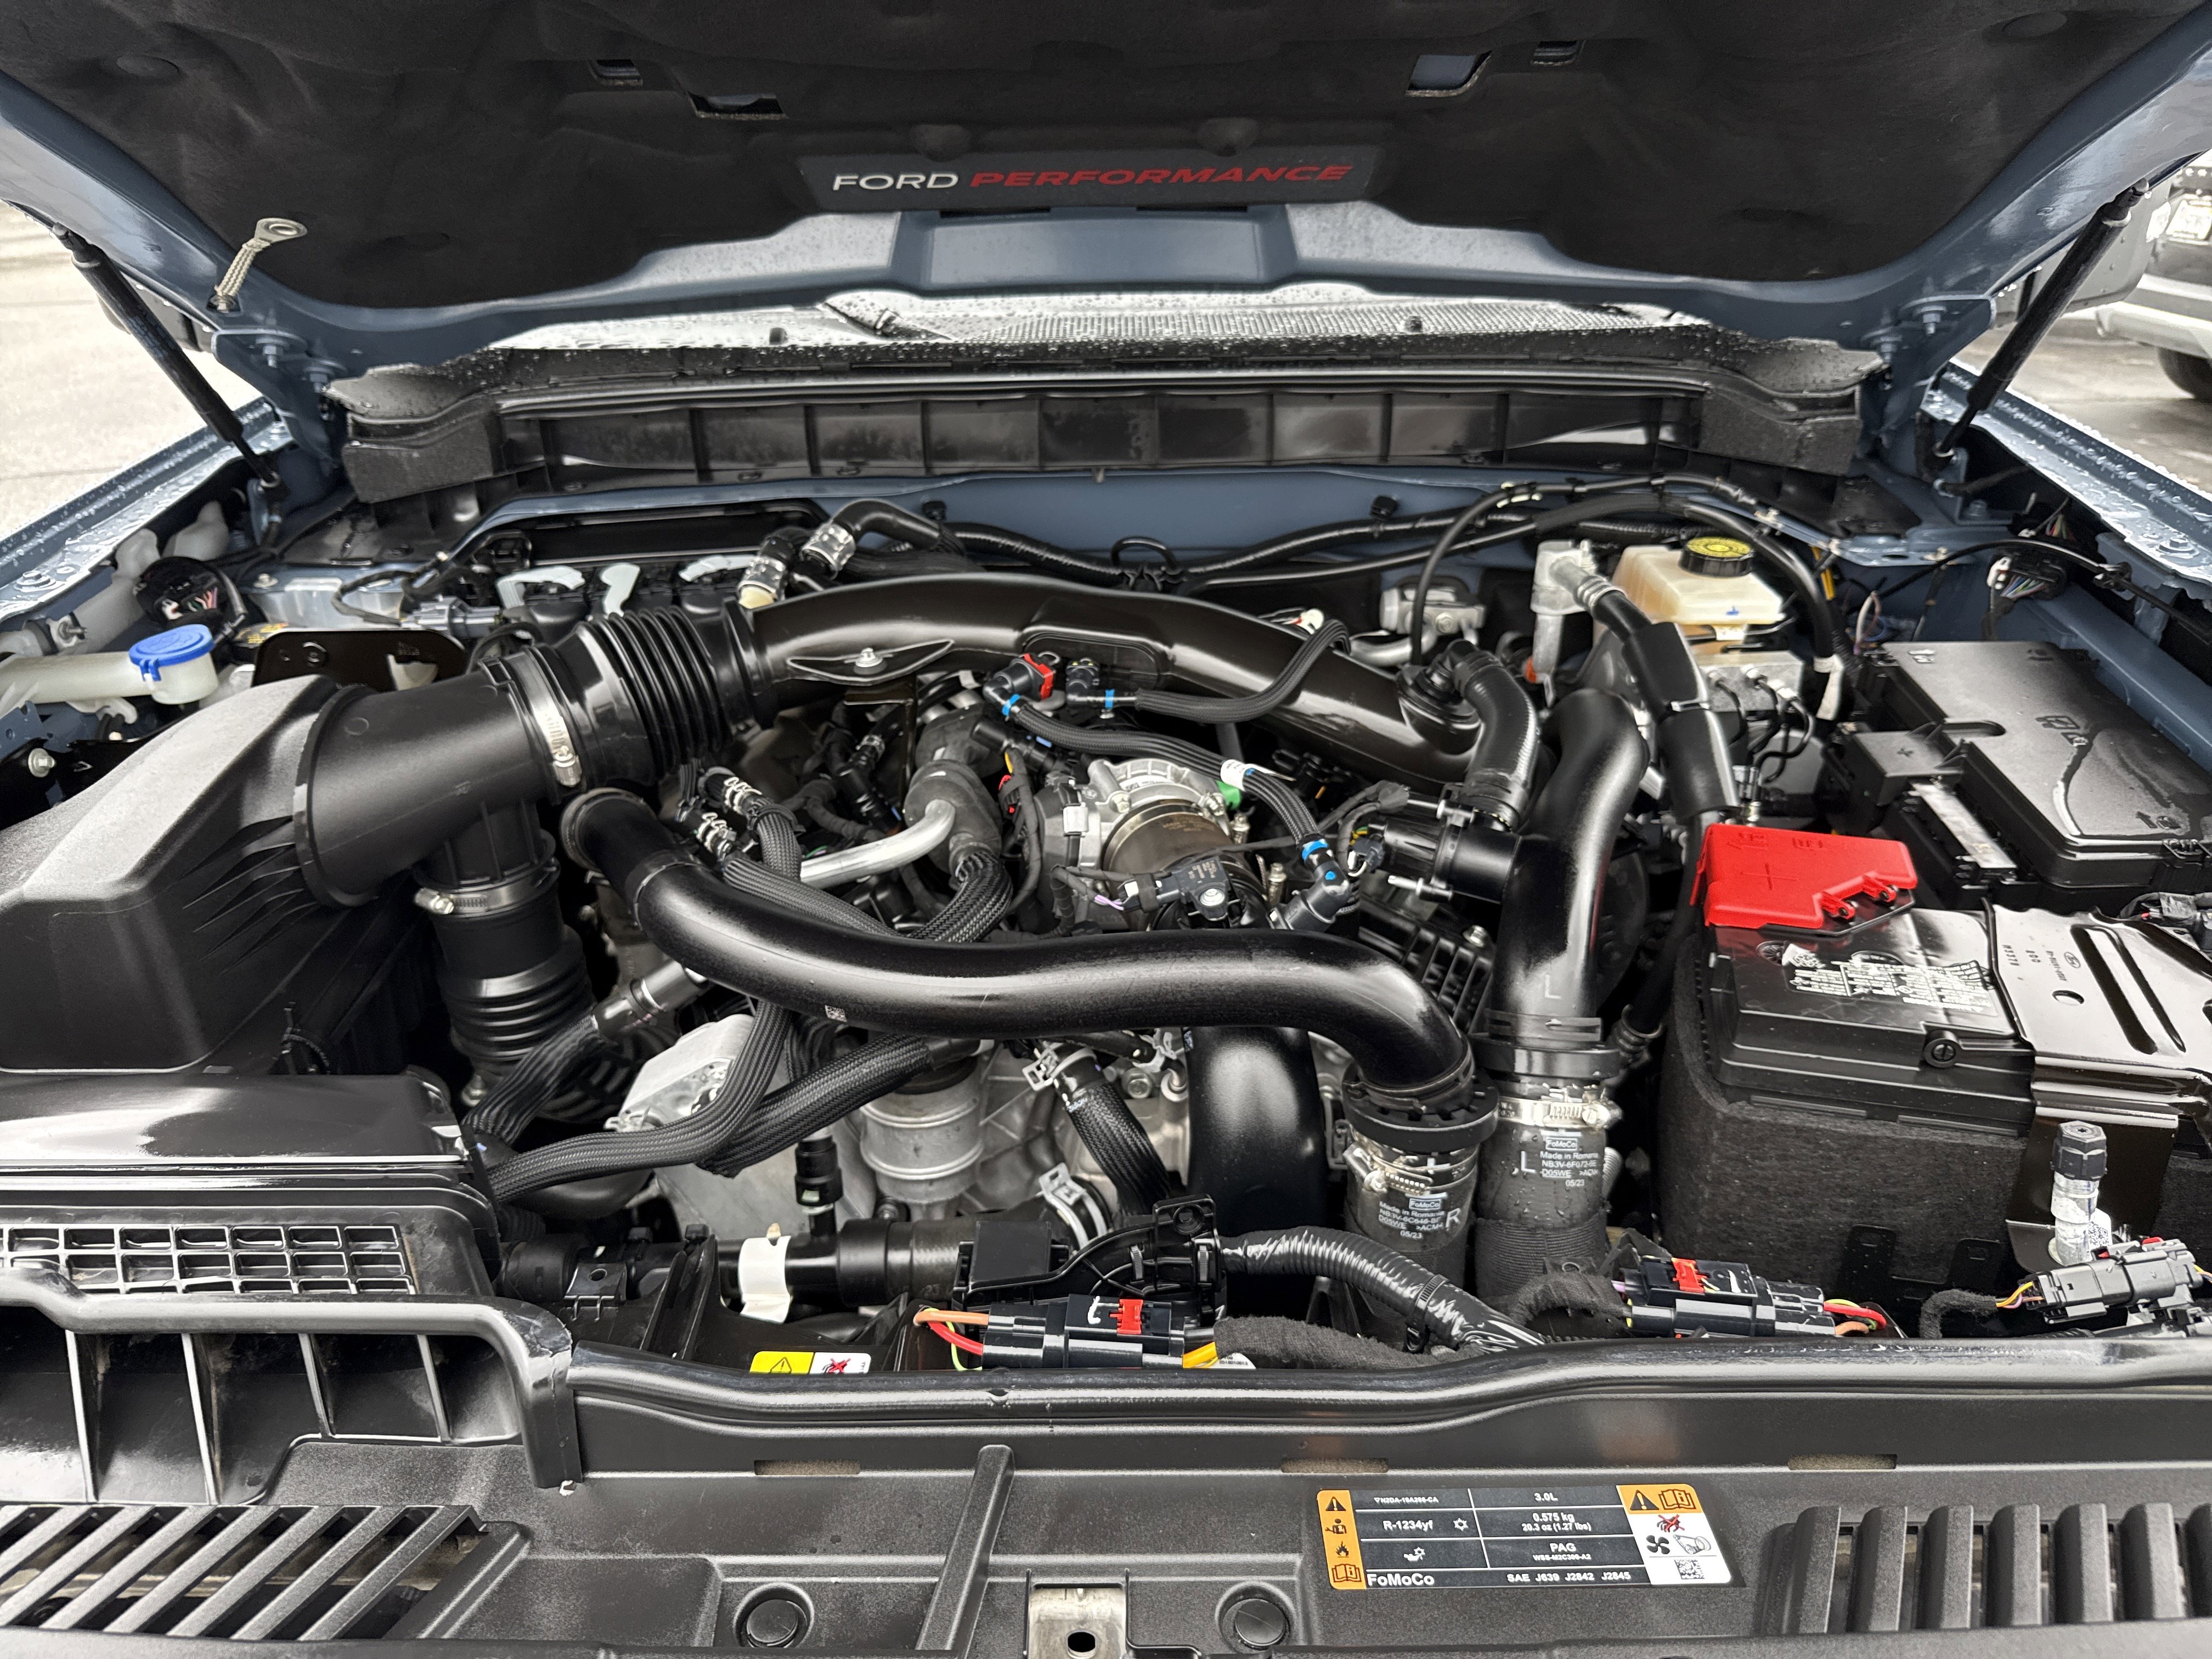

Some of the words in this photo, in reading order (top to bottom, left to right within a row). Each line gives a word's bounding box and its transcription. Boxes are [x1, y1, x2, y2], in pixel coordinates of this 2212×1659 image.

[832, 173, 959, 191] FORD
[969, 165, 1353, 188] PERFORMANCE
[1544, 974, 1561, 999] L
[1548, 1140, 1576, 1148] FoMoCo
[1540, 1151, 1562, 1160] Made
[1521, 1150, 1536, 1174] L
[1565, 1179, 1585, 1187] 05/23
[1379, 1201, 1400, 1213] Made
[1446, 1207, 1461, 1231] R
[1400, 1229, 1423, 1239] 05/23
[1534, 1492, 1558, 1502] 3.0L
[1532, 1512, 1560, 1522] 0.575
[1561, 1512, 1575, 1523] kg
[1383, 1520, 1433, 1532] R-1234yf
[1521, 1523, 1540, 1532] 20.3
[1553, 1522, 1573, 1532] (1.27
[1575, 1522, 1592, 1532] lbs)
[1549, 1542, 1577, 1553] PAG
[1366, 1572, 1435, 1587] FoMoCo
[1507, 1573, 1530, 1582] SAE
[1535, 1573, 1560, 1582] J639
[1565, 1572, 1595, 1582] J2842
[1601, 1571, 1632, 1581] J2845
